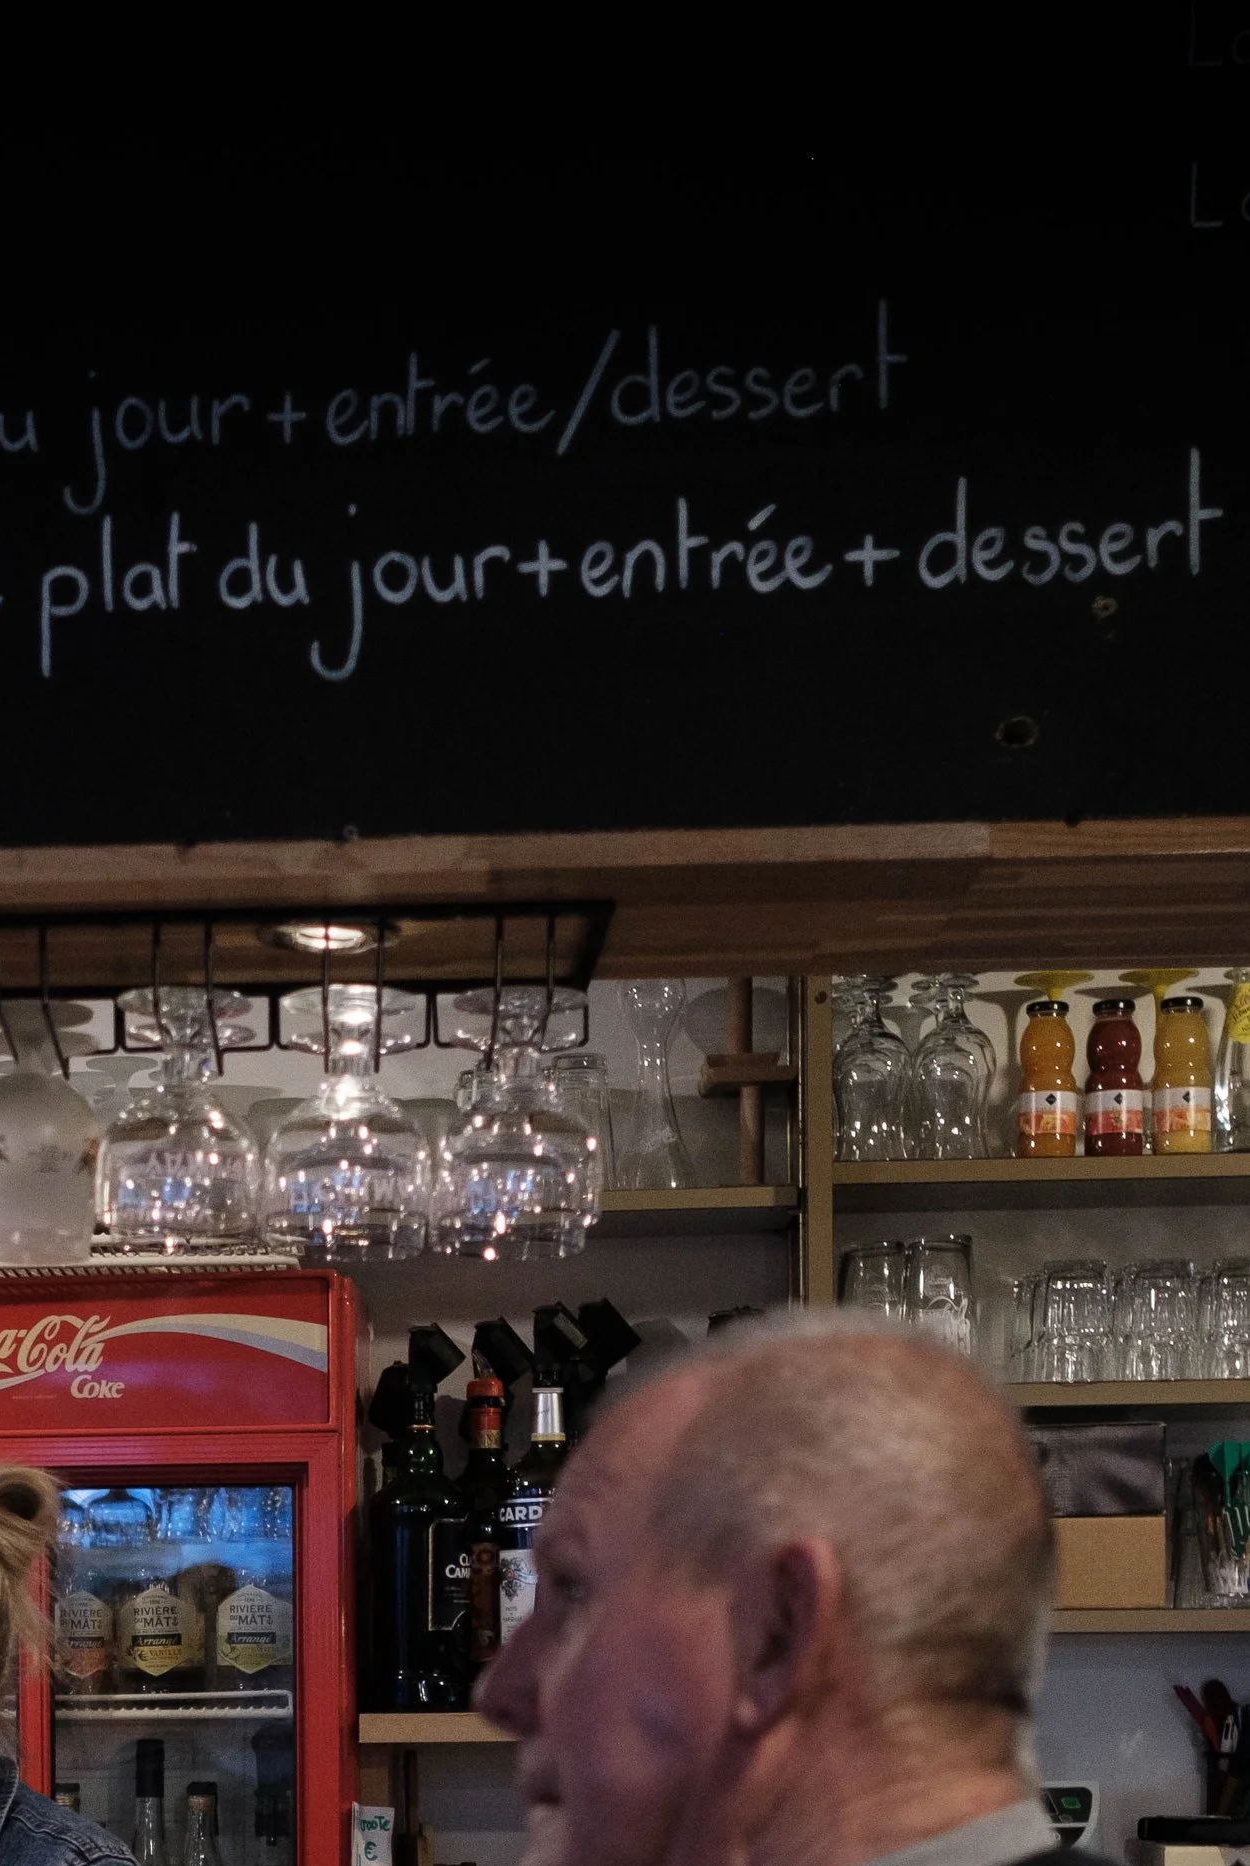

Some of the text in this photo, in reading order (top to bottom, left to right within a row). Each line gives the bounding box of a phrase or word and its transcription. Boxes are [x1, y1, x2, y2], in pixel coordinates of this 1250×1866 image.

[39, 508, 199, 680] plat
[216, 518, 311, 609] du
[917, 445, 1225, 592] dessert
[70, 1374, 126, 1400] Coke
[500, 1505, 543, 1521] CARD
